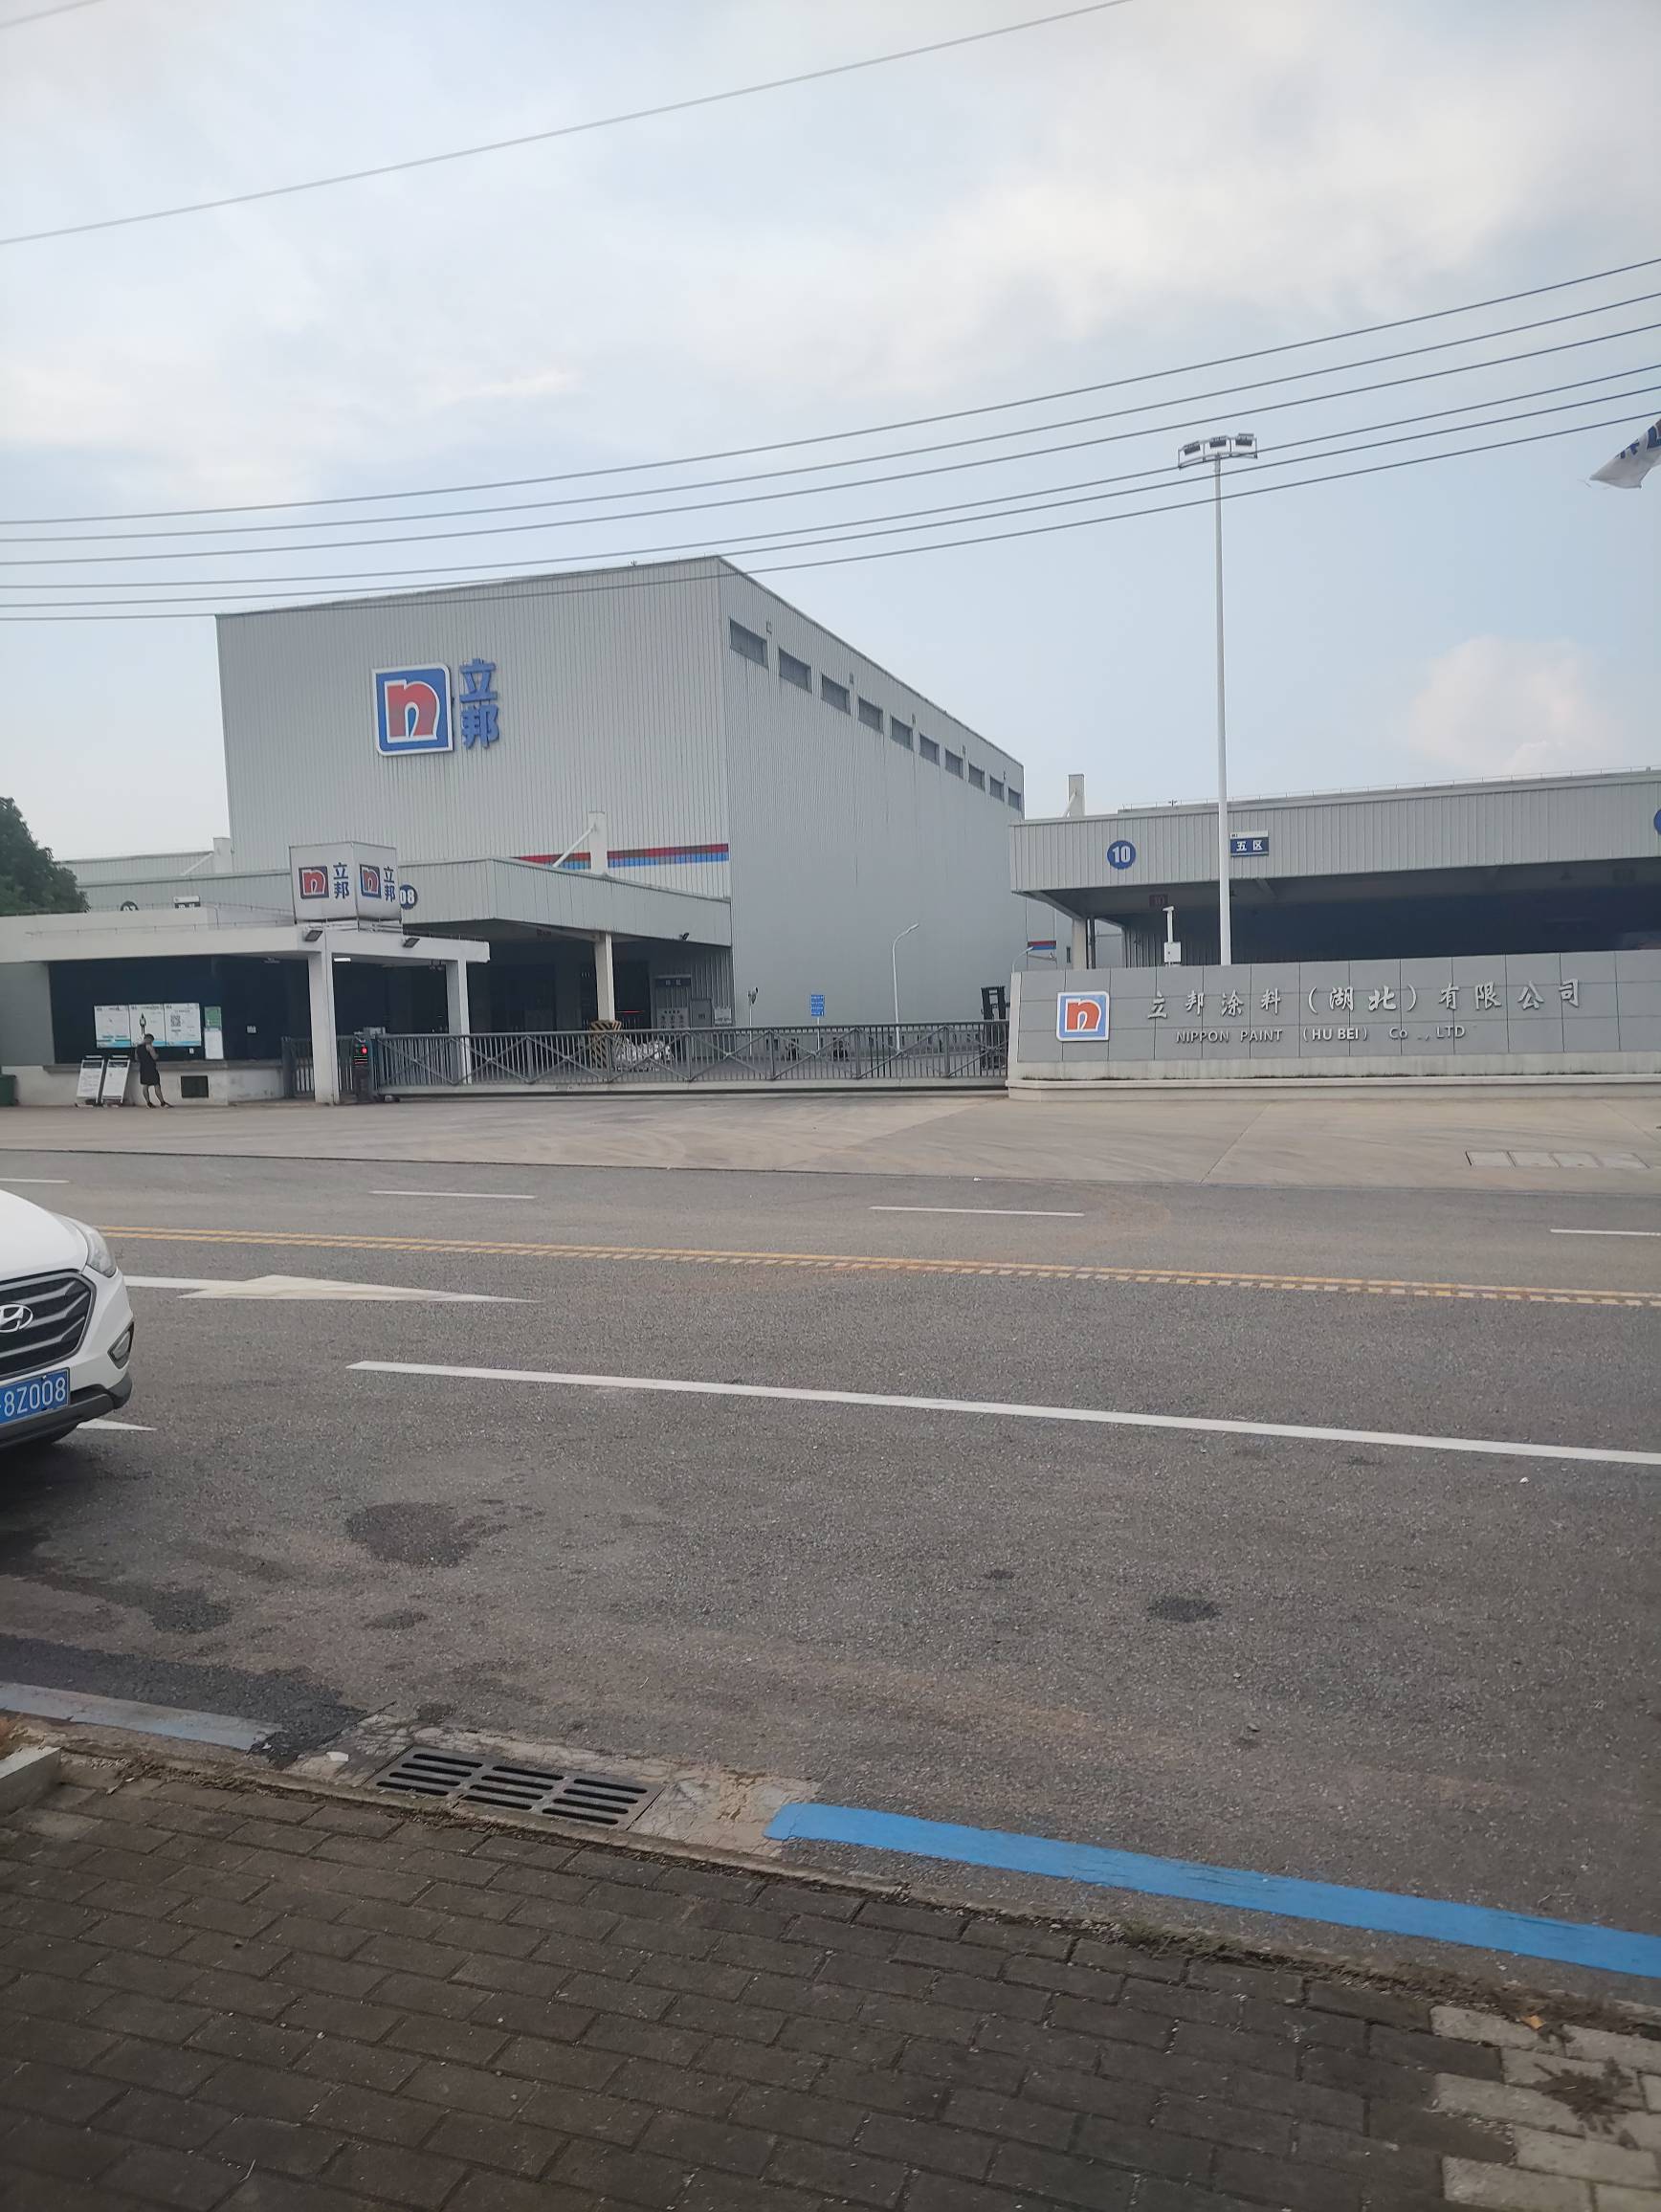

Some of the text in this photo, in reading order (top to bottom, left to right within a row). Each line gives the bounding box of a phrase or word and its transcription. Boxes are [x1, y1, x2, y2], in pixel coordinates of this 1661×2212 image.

[459, 658, 499, 749] 立邦
[1112, 845, 1131, 863] 10
[1236, 839, 1263, 852] 五区
[333, 862, 349, 899] 立邦
[383, 866, 395, 902] 立邦
[399, 889, 415, 905] 08
[1175, 1030, 1229, 1044] NIPPON
[1240, 1029, 1283, 1043] PAINT
[4, 1377, 66, 1417] 8Z008
